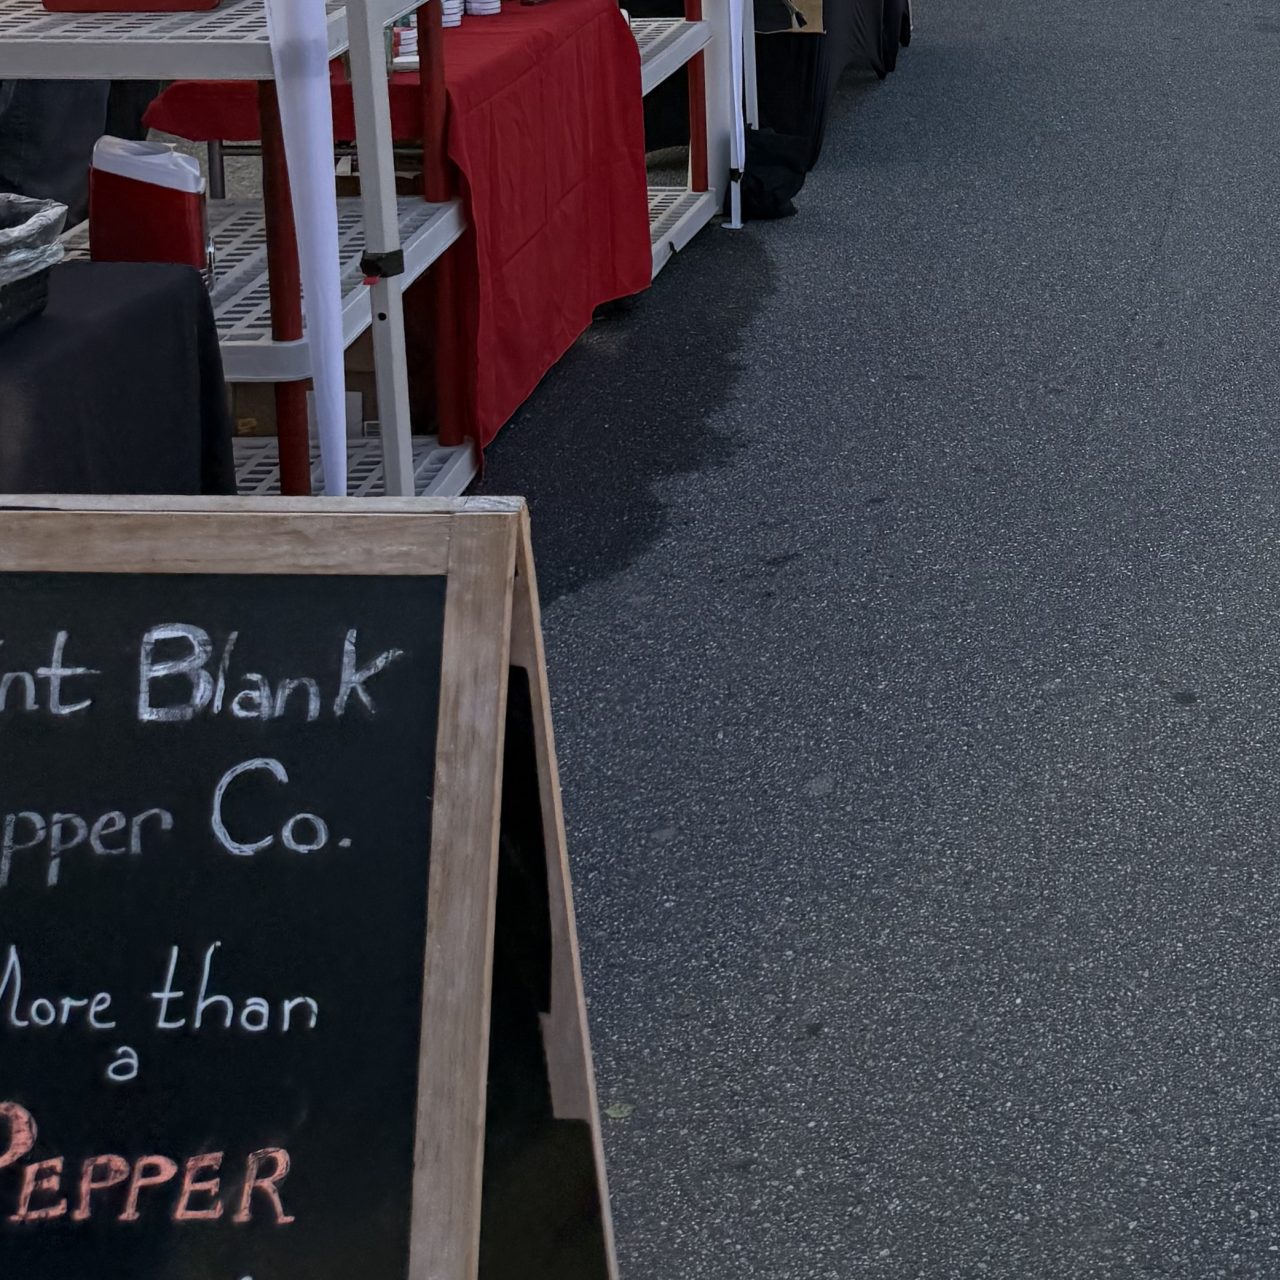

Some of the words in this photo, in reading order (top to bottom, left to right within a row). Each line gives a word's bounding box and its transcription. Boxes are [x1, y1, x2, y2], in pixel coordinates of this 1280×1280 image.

[138, 622, 404, 722] Blank
[211, 757, 352, 856] Co.
[151, 940, 319, 1033] than
[106, 1045, 140, 1082] a
